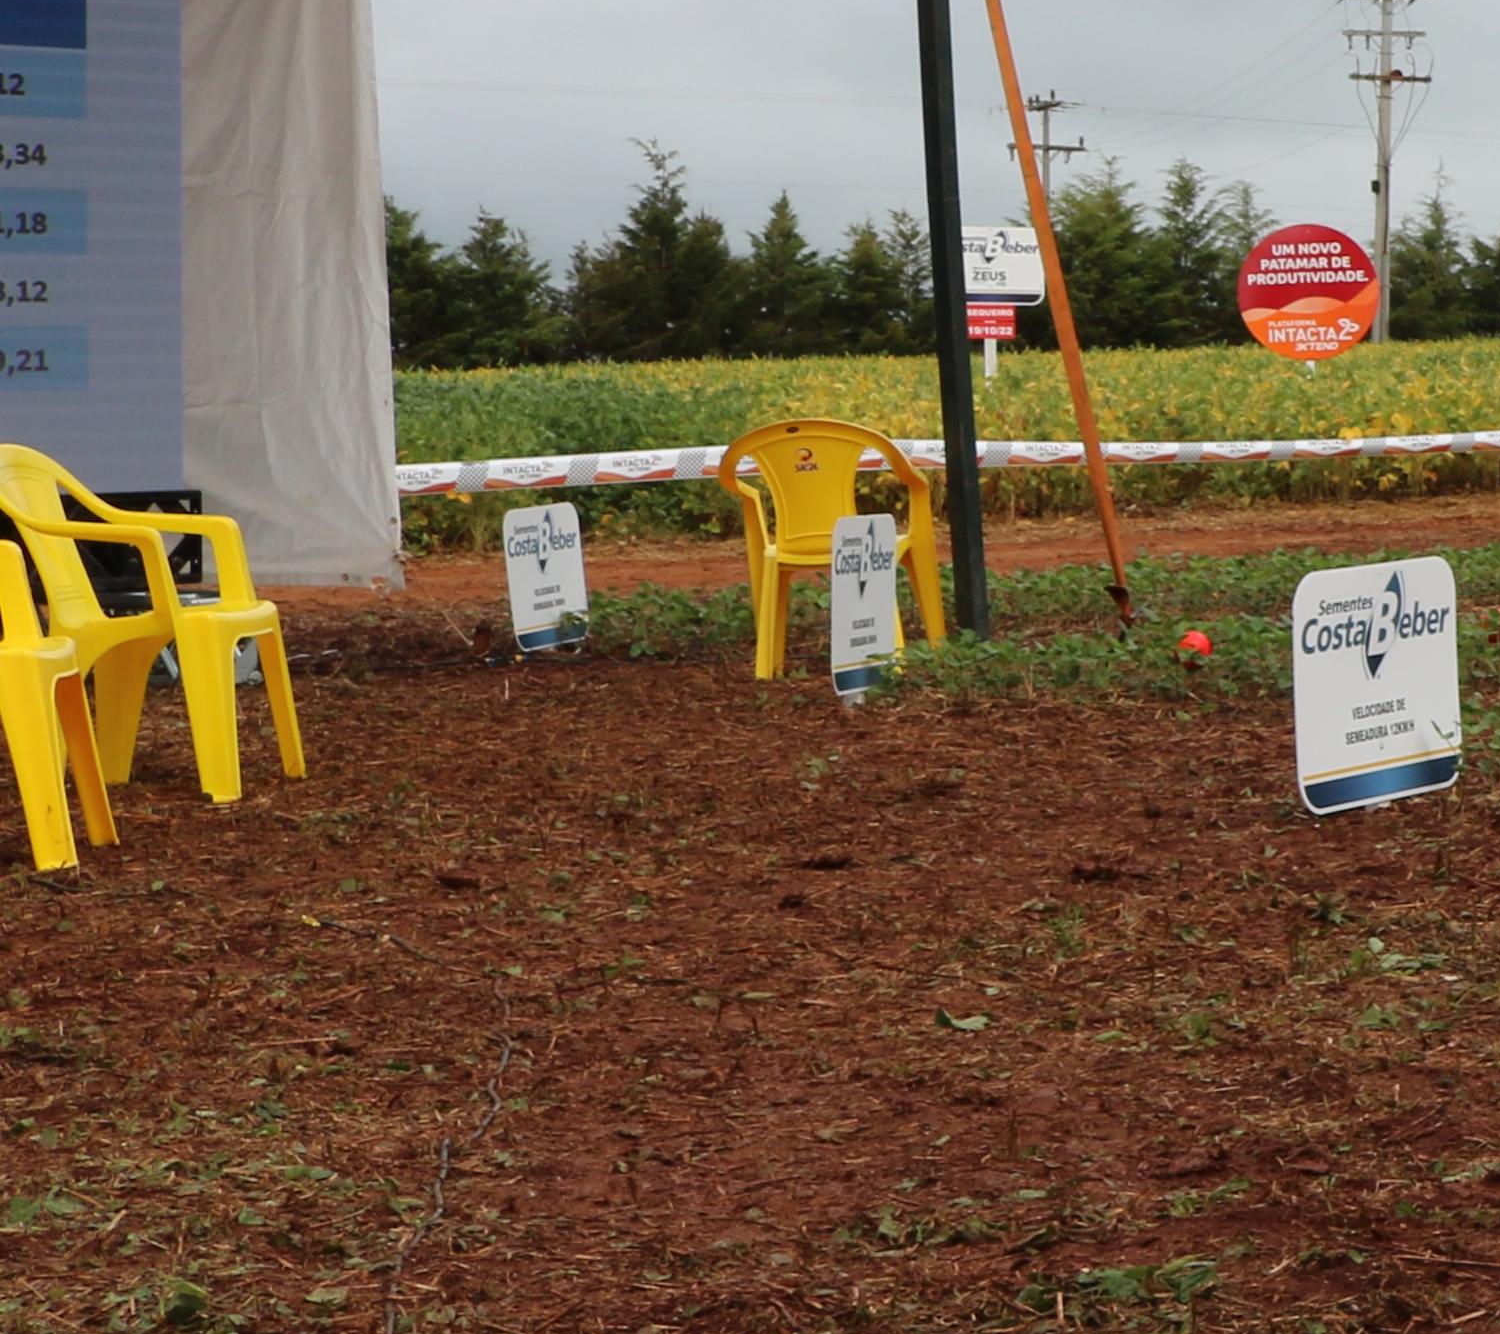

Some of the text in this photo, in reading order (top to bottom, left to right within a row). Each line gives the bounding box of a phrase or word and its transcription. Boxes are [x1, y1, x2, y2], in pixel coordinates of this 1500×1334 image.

[0, 144, 46, 169] ,34
[0, 212, 47, 238] ,18
[1272, 242, 1341, 256] UM NOVO
[1260, 256, 1351, 270] PATAMAR DE
[972, 271, 1006, 281] ZEUS
[1247, 270, 1368, 285] PRODUTIVIDADE.
[968, 326, 1013, 335] 19/10/22
[1318, 595, 1373, 616] Sementes
[1351, 697, 1406, 720] VELOCIDADE DE
[1345, 725, 1389, 745] SEMEADURA
